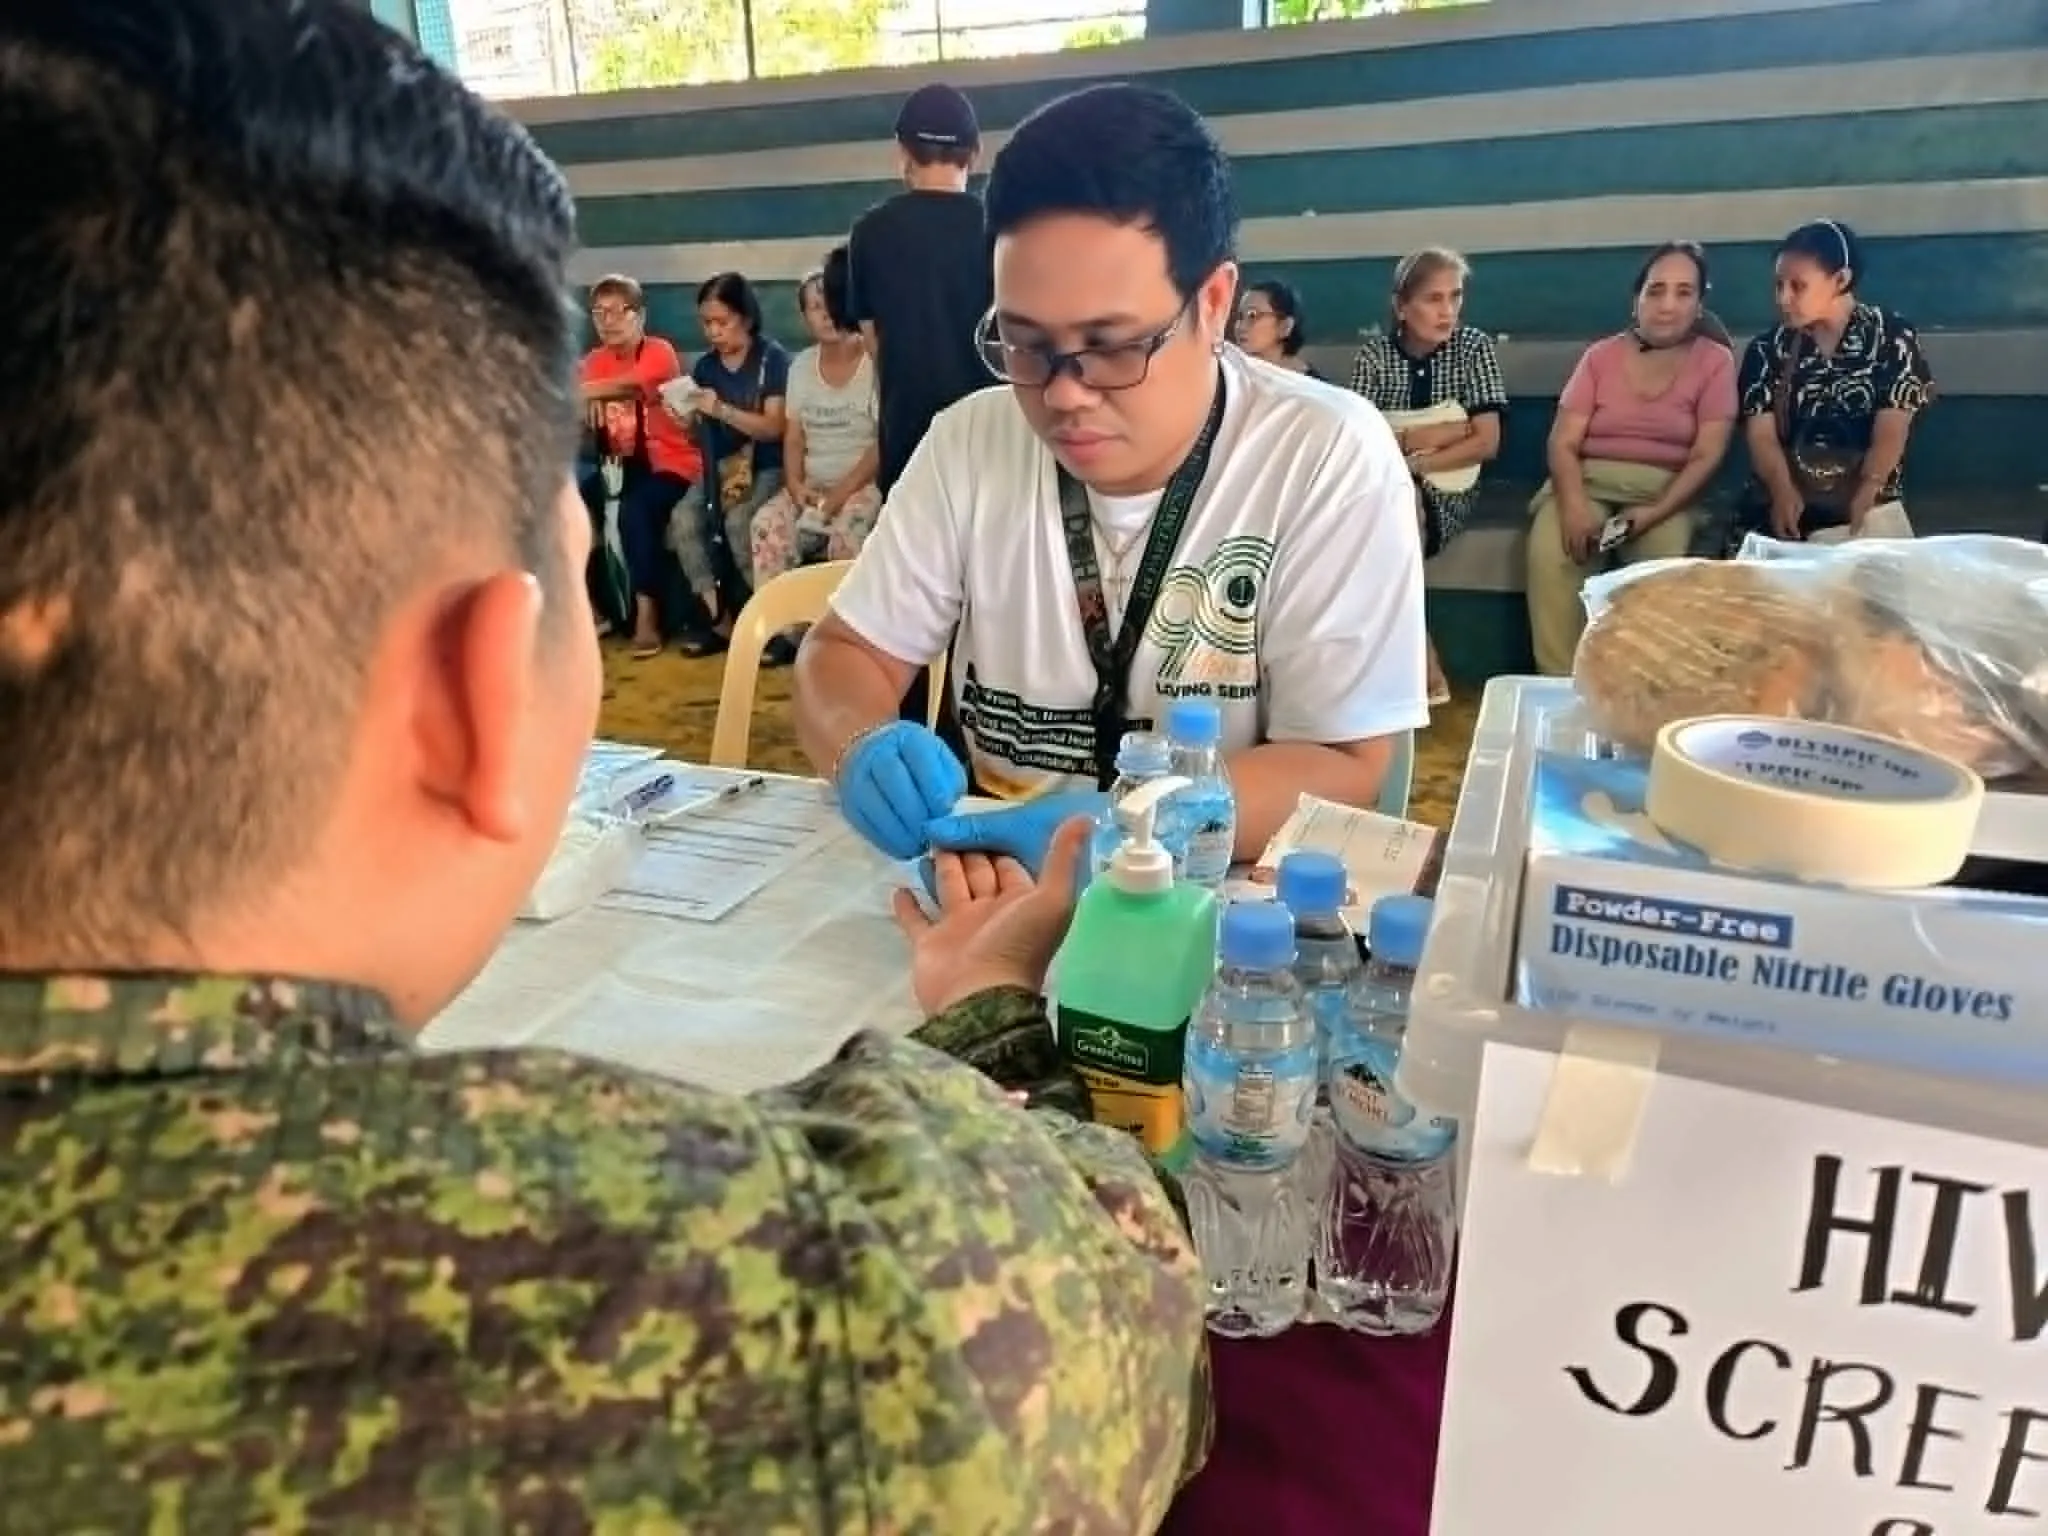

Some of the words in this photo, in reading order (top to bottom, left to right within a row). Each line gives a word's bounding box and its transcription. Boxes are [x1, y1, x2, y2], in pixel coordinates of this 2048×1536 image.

[1776, 735, 1879, 765] OLYMPIC
[1567, 892, 1781, 943] Powder-Free
[1551, 923, 1740, 982] Disposable
[1752, 953, 1869, 1001] Nitrile
[1882, 973, 2013, 1021] Gloves
[1562, 1300, 2048, 1518] SCREE
